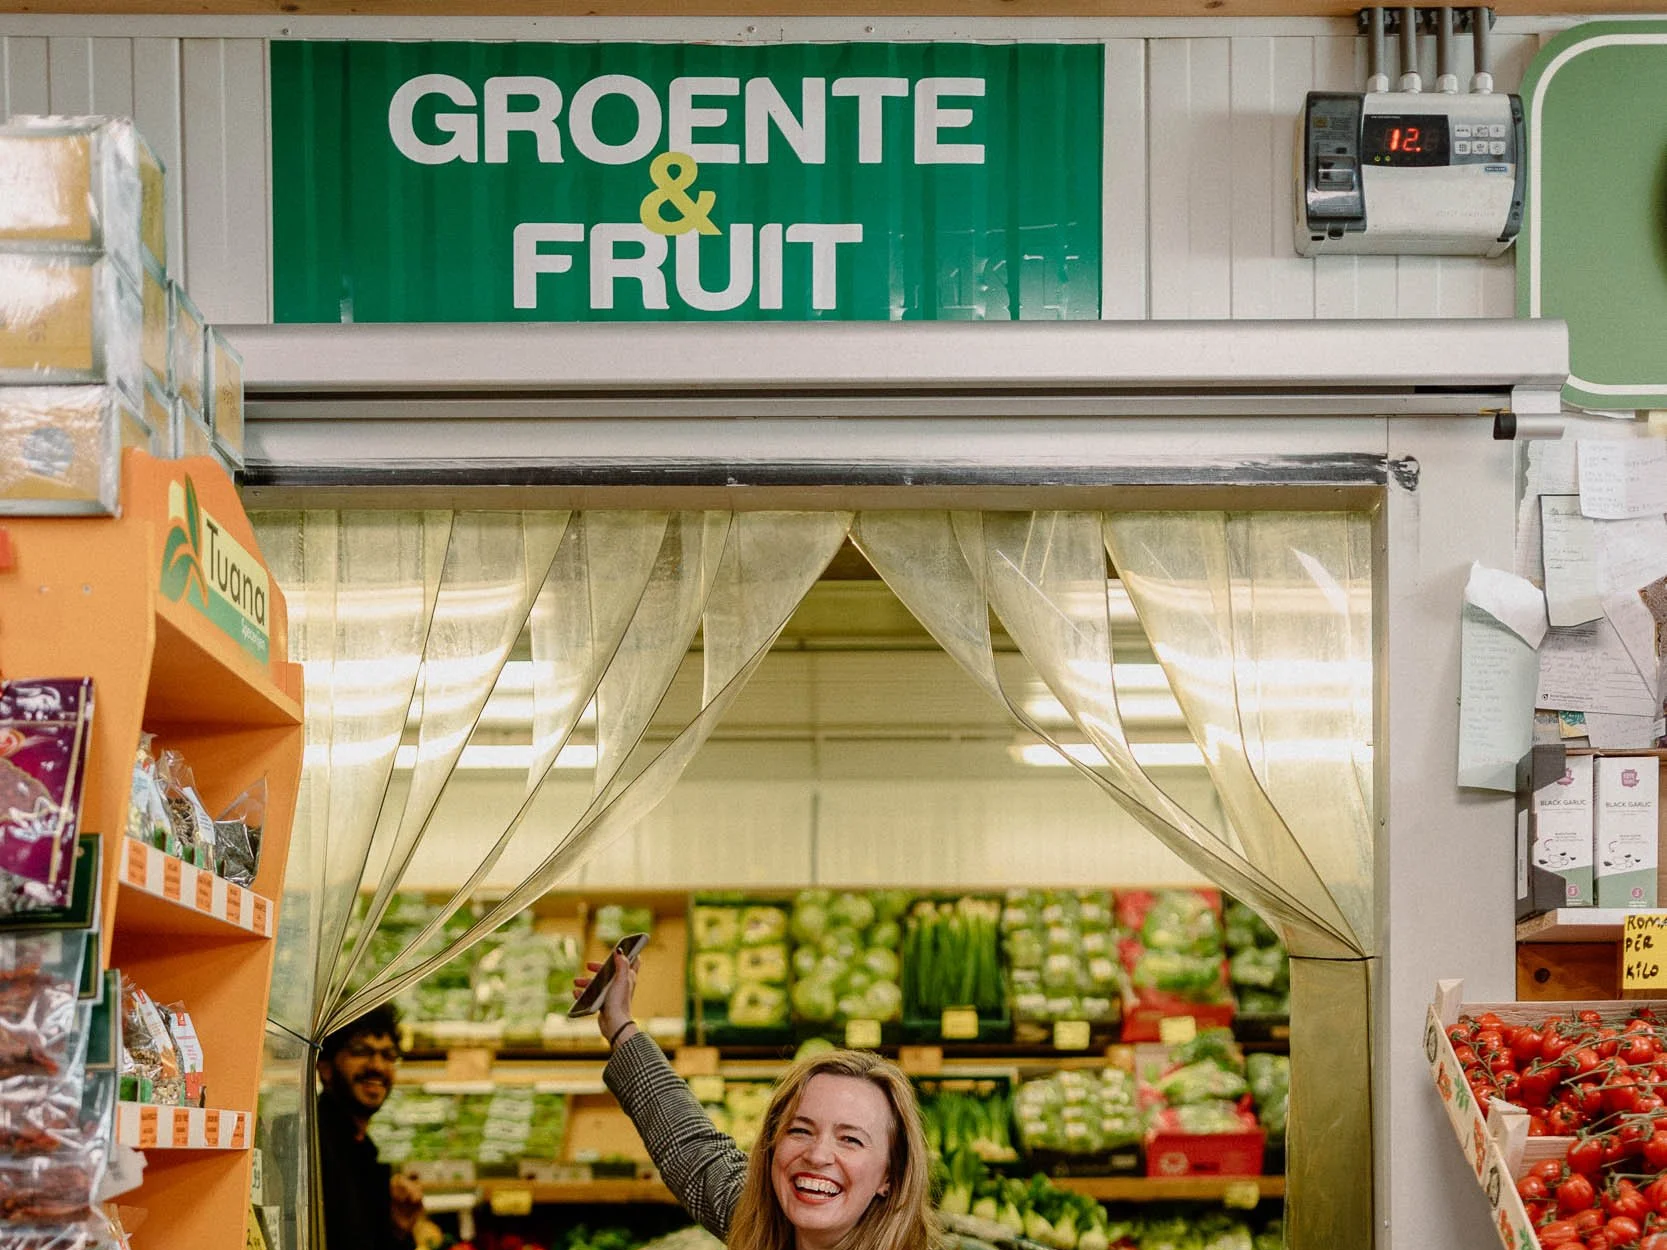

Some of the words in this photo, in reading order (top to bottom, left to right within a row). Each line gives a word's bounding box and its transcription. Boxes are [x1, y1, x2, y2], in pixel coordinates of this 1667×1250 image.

[388, 74, 986, 165] GROENTE
[640, 151, 722, 236] &
[513, 223, 863, 312] FRUIT
[206, 518, 265, 626] Tuana
